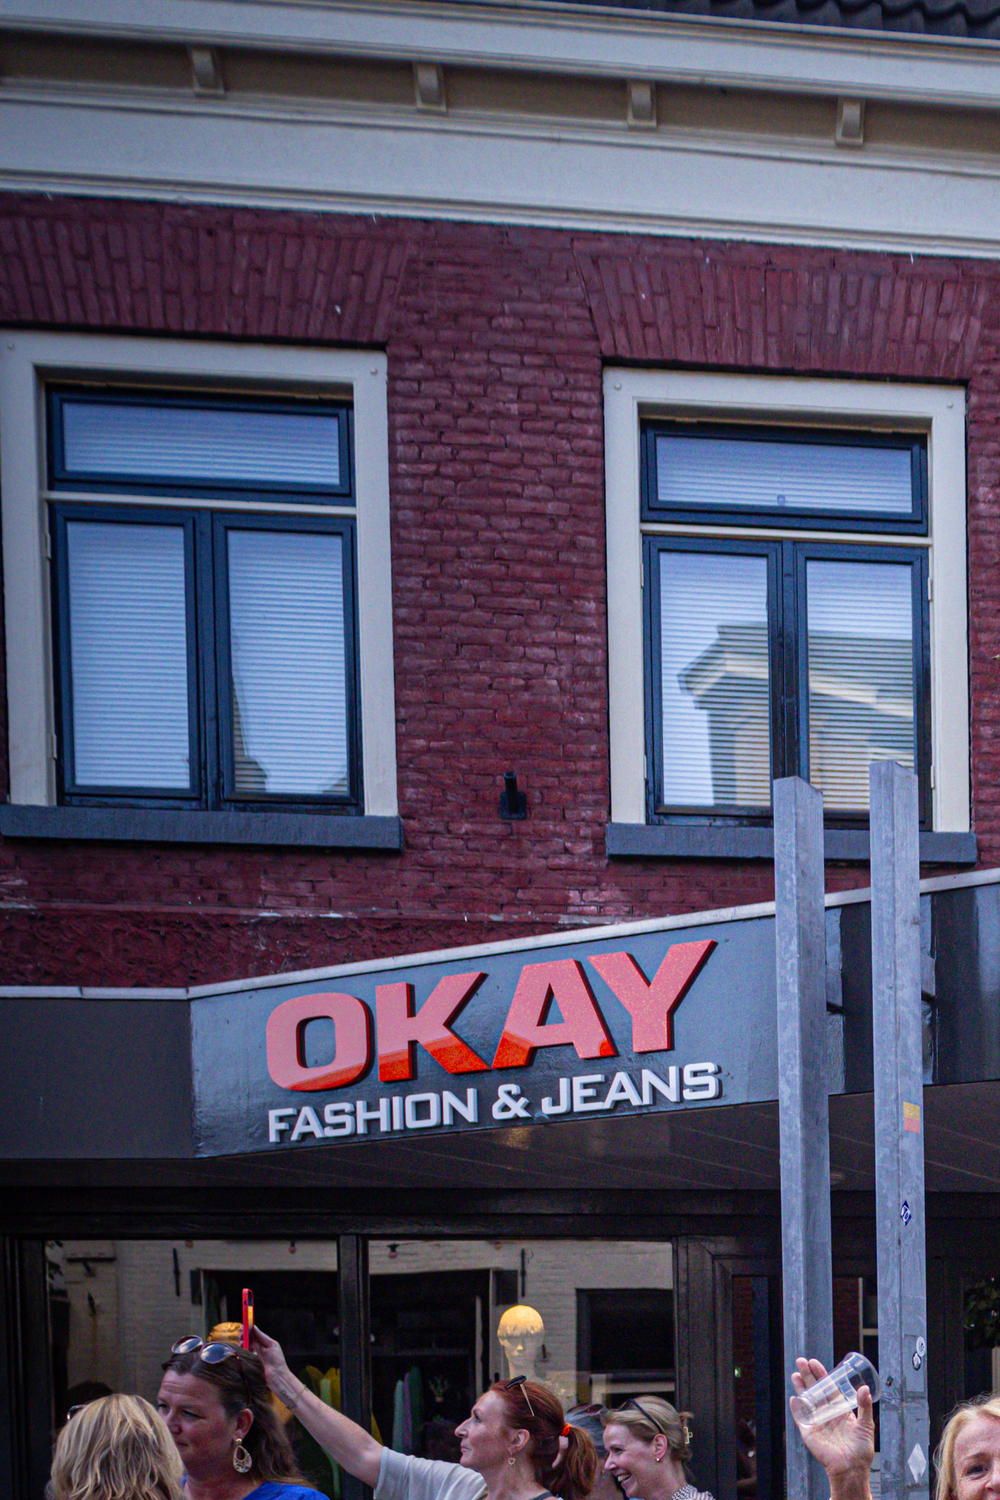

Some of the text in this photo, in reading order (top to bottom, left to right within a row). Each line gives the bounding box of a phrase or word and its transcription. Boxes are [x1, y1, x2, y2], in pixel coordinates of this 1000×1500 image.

[265, 940, 718, 1091] OKAY
[268, 1062, 720, 1143] FASHION & JEANS
